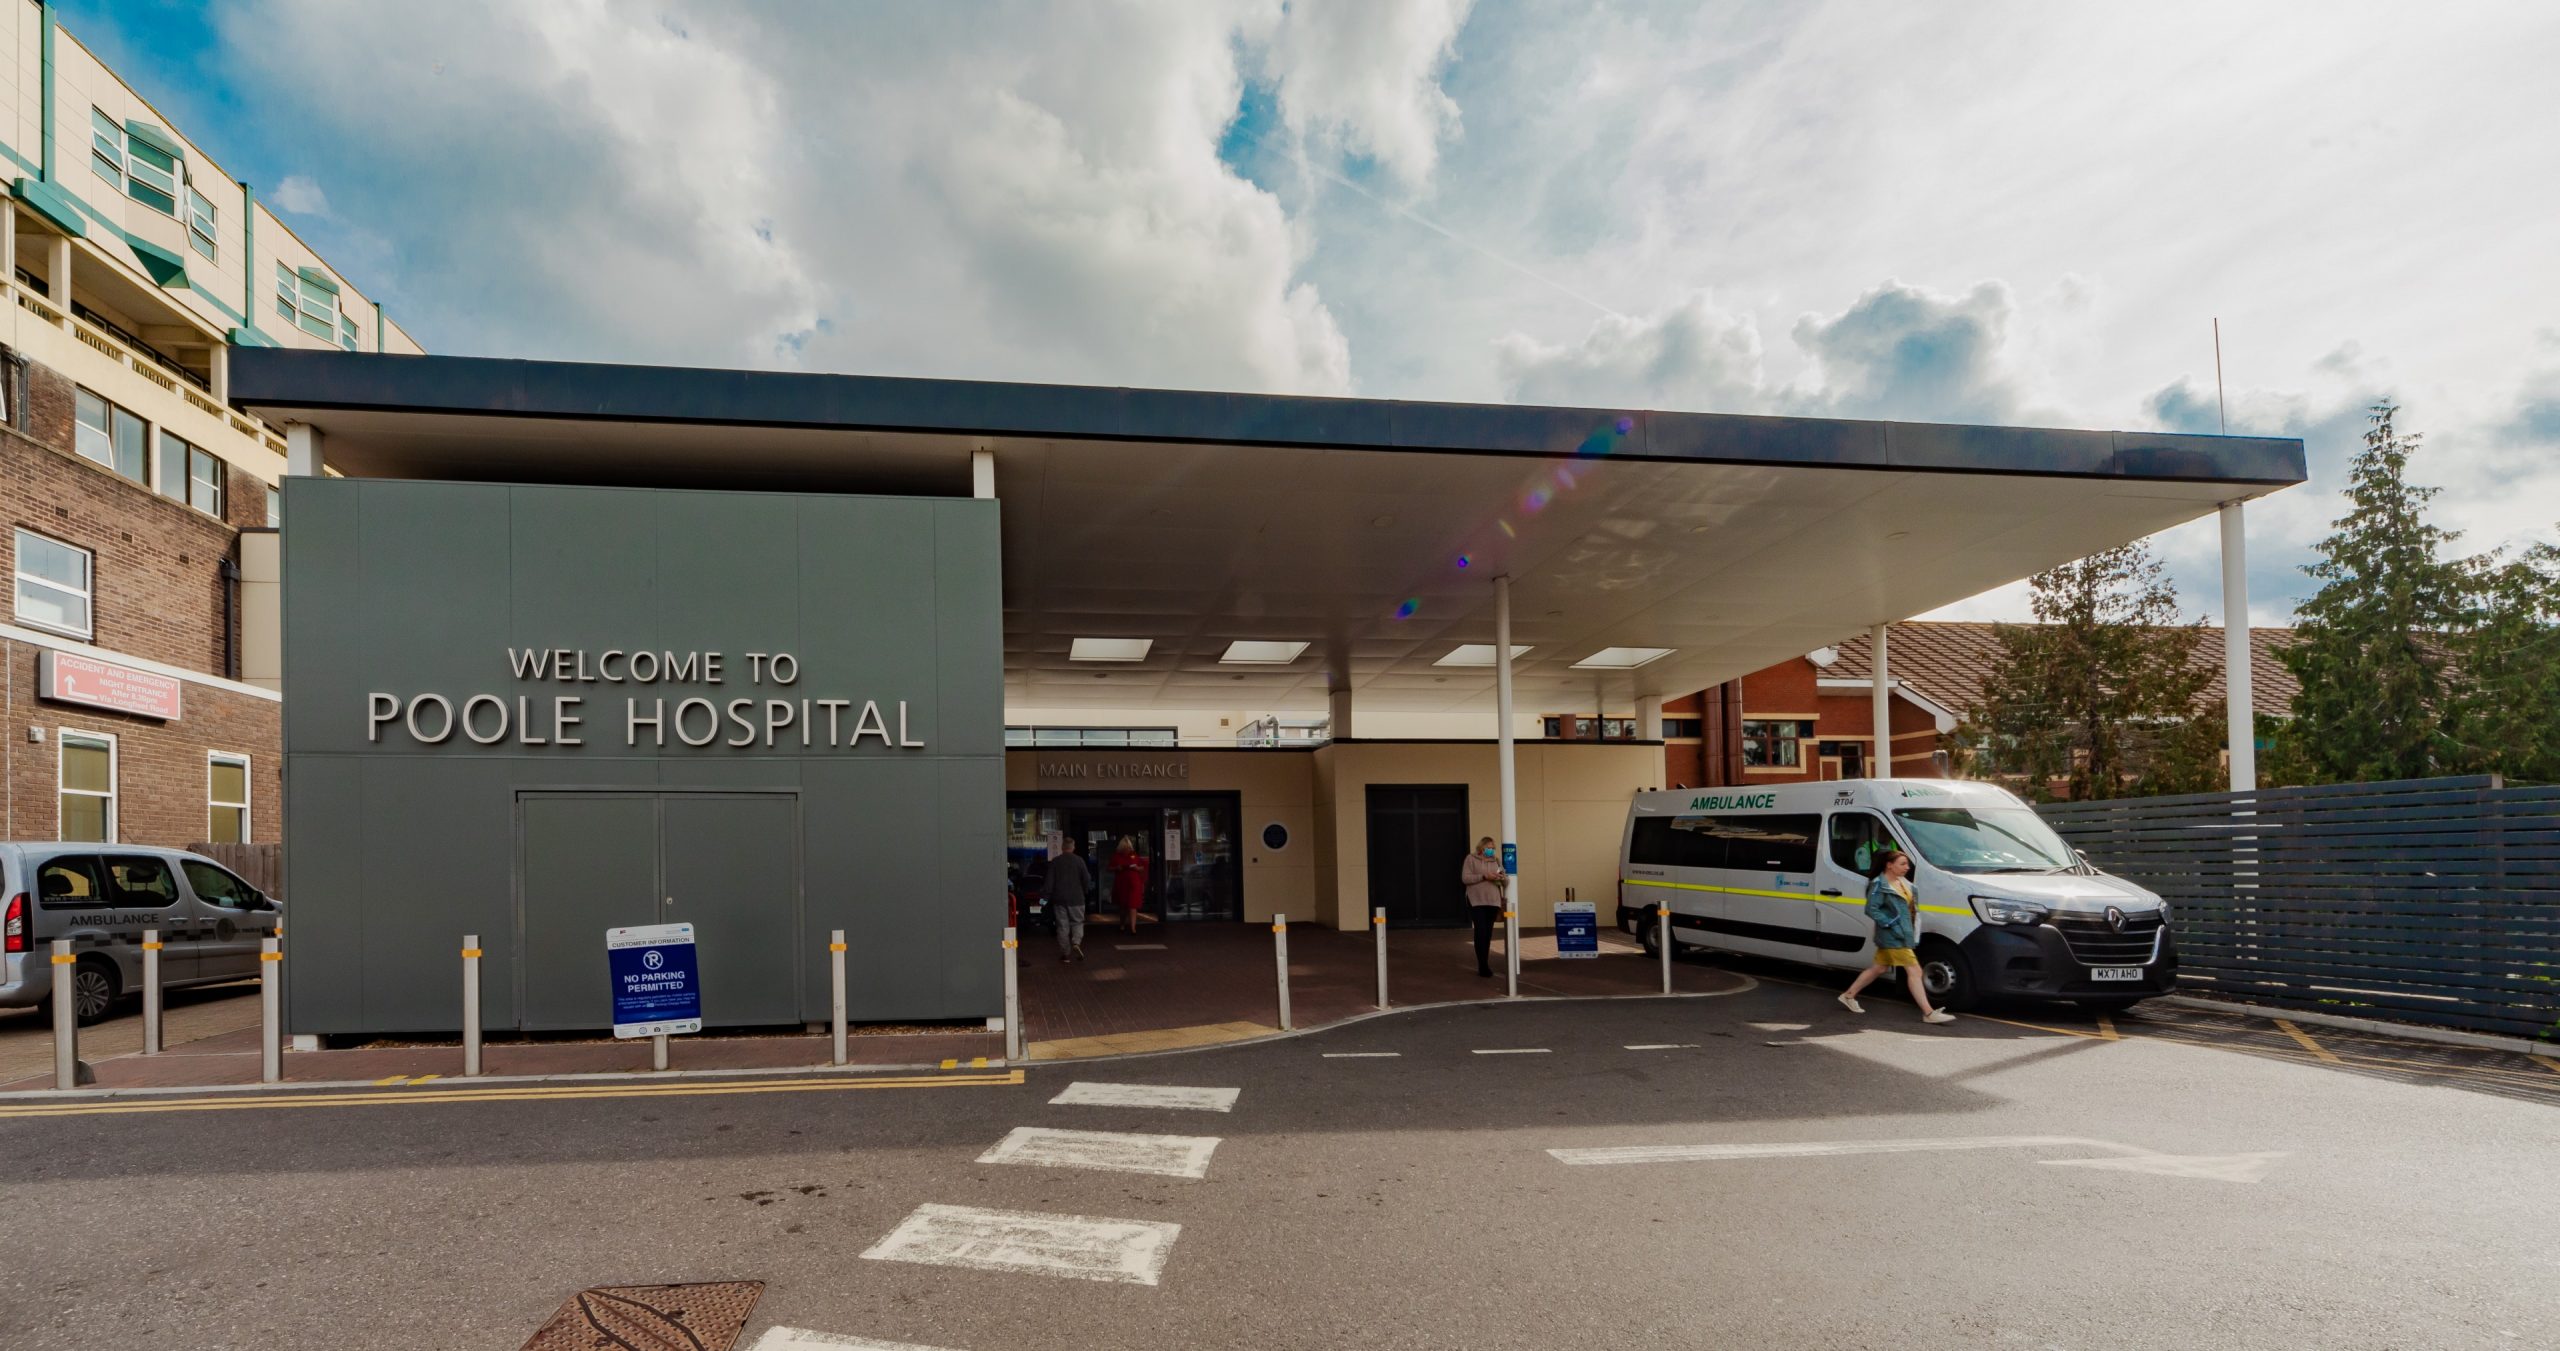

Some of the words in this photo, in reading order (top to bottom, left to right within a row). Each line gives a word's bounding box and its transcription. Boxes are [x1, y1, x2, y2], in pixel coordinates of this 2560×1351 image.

[508, 647, 724, 683] WELCOME
[746, 652, 800, 685] TO
[60, 657, 105, 675] ACCIDENT
[106, 667, 124, 679] AND
[126, 671, 175, 690] EMERGENCY
[98, 678, 124, 690] NIGHT
[126, 683, 169, 699] ENTRANCE
[98, 693, 112, 703] Via
[368, 692, 584, 745] POOLE
[626, 697, 925, 748] HOSPITAL
[1040, 763, 1087, 777] MAIN
[1097, 763, 1189, 778] ENTRANCE
[1690, 794, 1776, 810] AMBULANCE
[1833, 798, 1854, 806] RT04
[69, 913, 159, 926] AMBULANCE
[612, 940, 646, 948] CUSTOMER
[624, 974, 639, 983] NO
[641, 971, 685, 982] PARKING
[627, 981, 684, 993] PERMITTED
